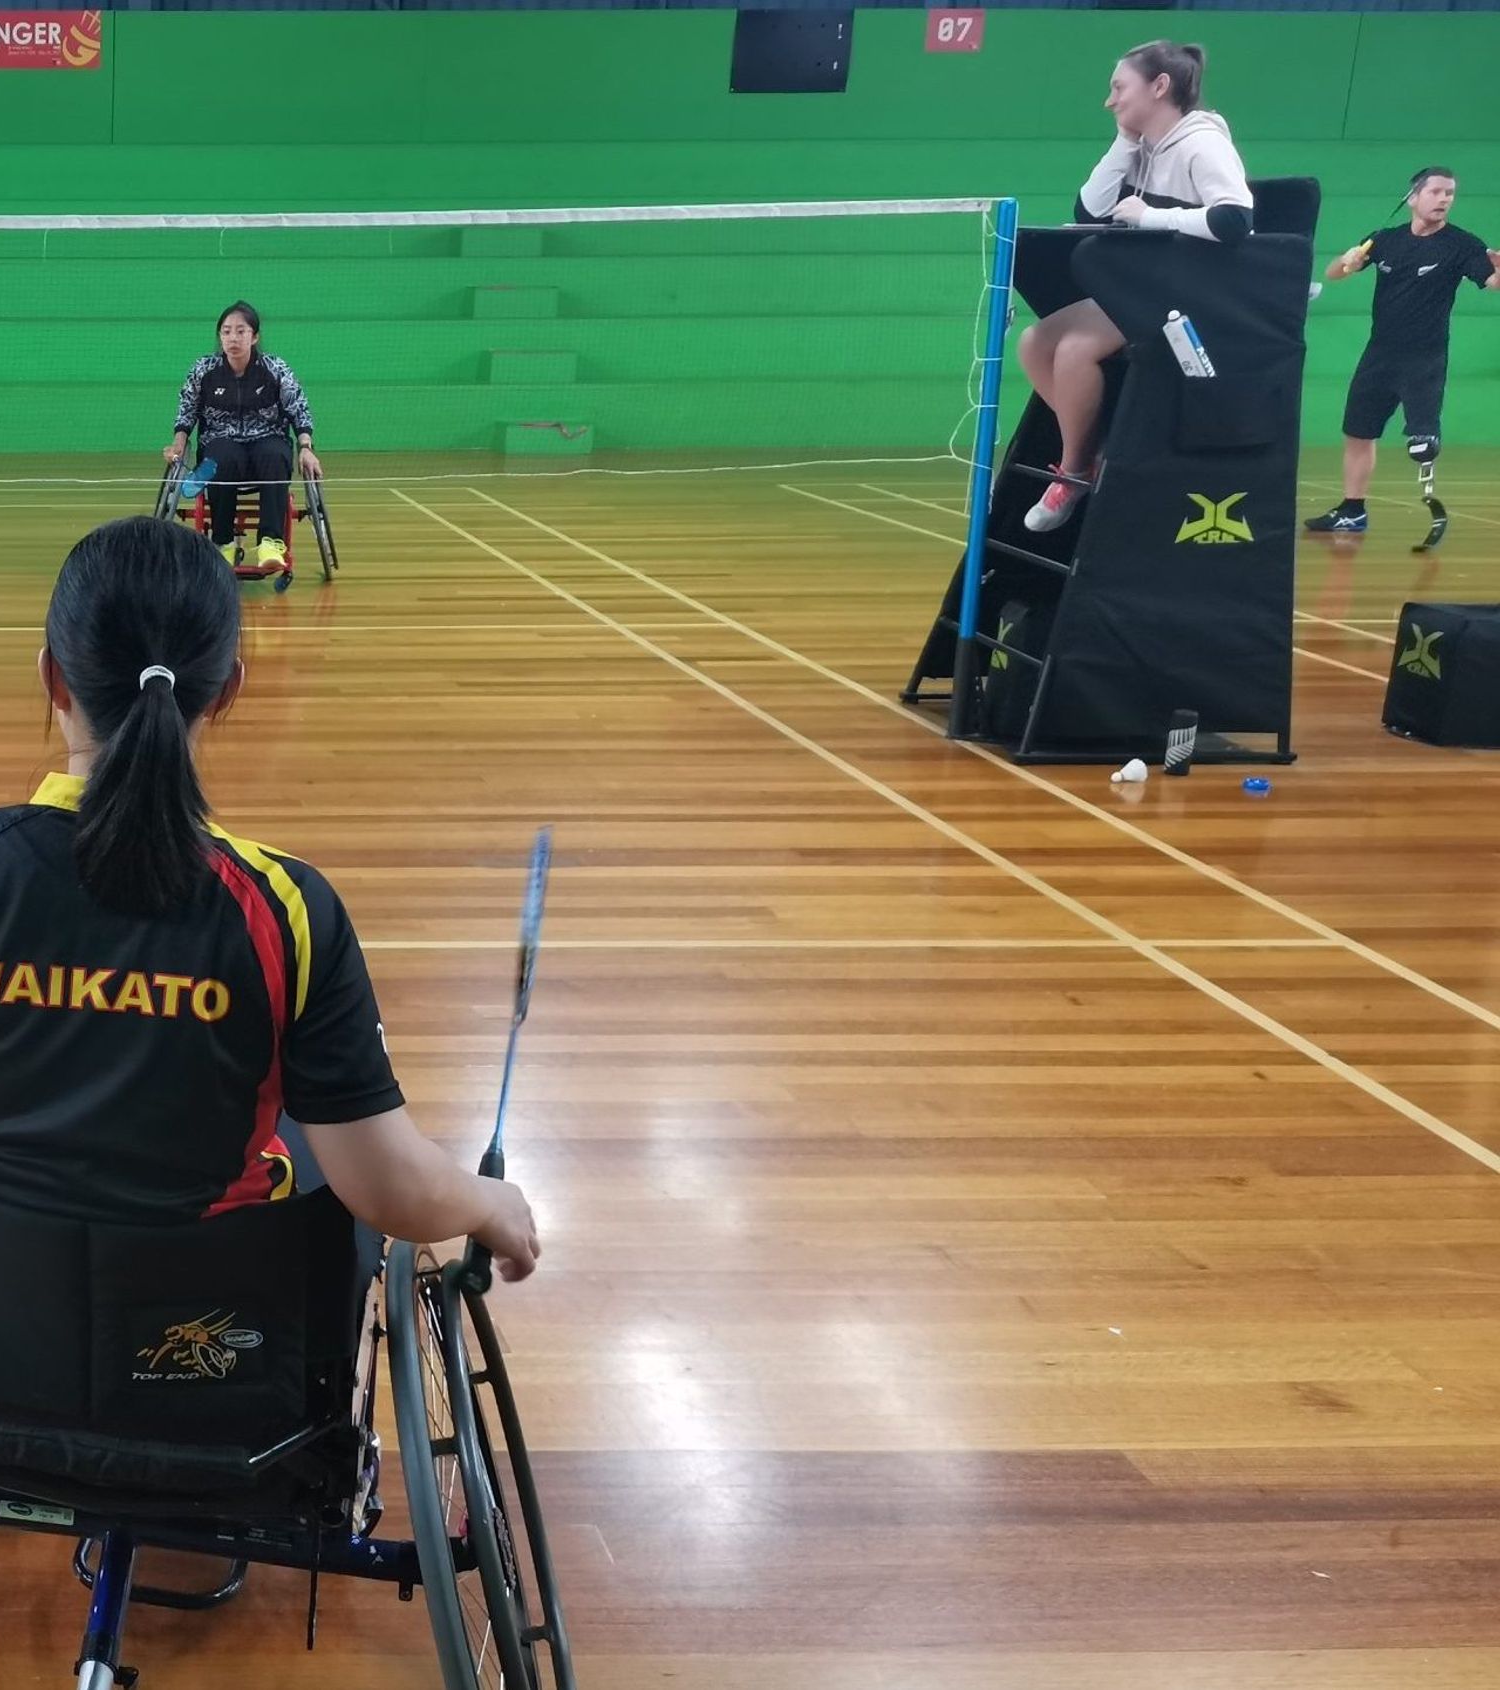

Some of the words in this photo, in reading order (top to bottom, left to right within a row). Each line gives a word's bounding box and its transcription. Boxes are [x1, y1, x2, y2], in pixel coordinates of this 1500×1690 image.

[937, 17, 973, 42] 07
[131, 1372, 162, 1380] TOP
[165, 1372, 200, 1380] END
